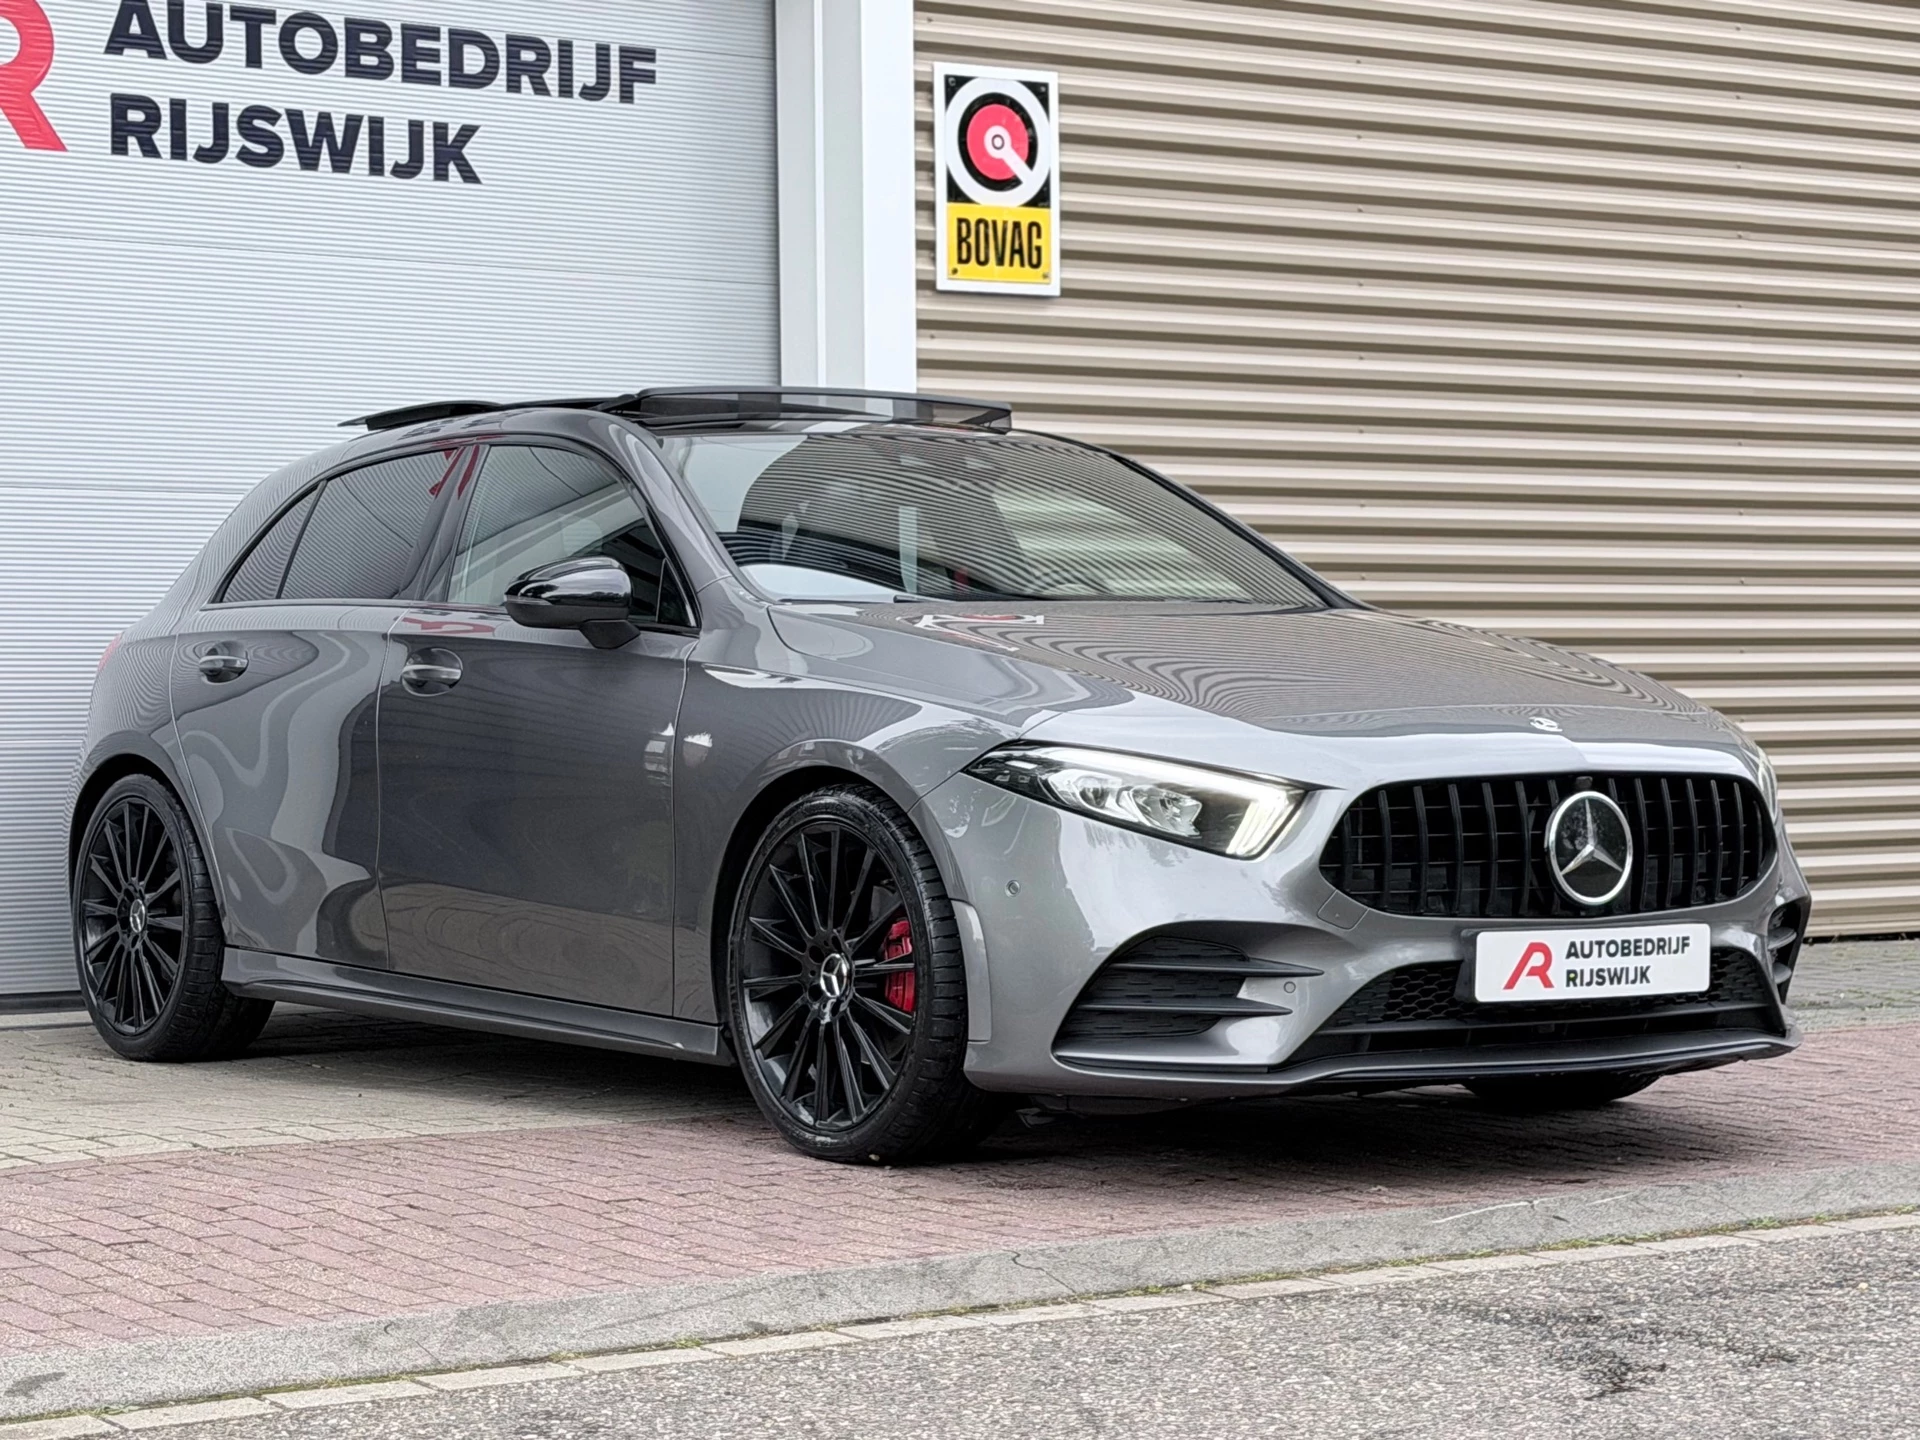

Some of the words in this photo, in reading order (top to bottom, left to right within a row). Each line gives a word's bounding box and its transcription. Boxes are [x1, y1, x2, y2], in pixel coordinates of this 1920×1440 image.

[104, 0, 657, 104] AUTOBEDRIJF
[110, 92, 483, 184] RIJSWIJK
[956, 217, 1042, 269] BOVAG
[1565, 936, 1691, 960] AUTOBEDRIJF
[1565, 966, 1651, 987] RIJSWIJK
